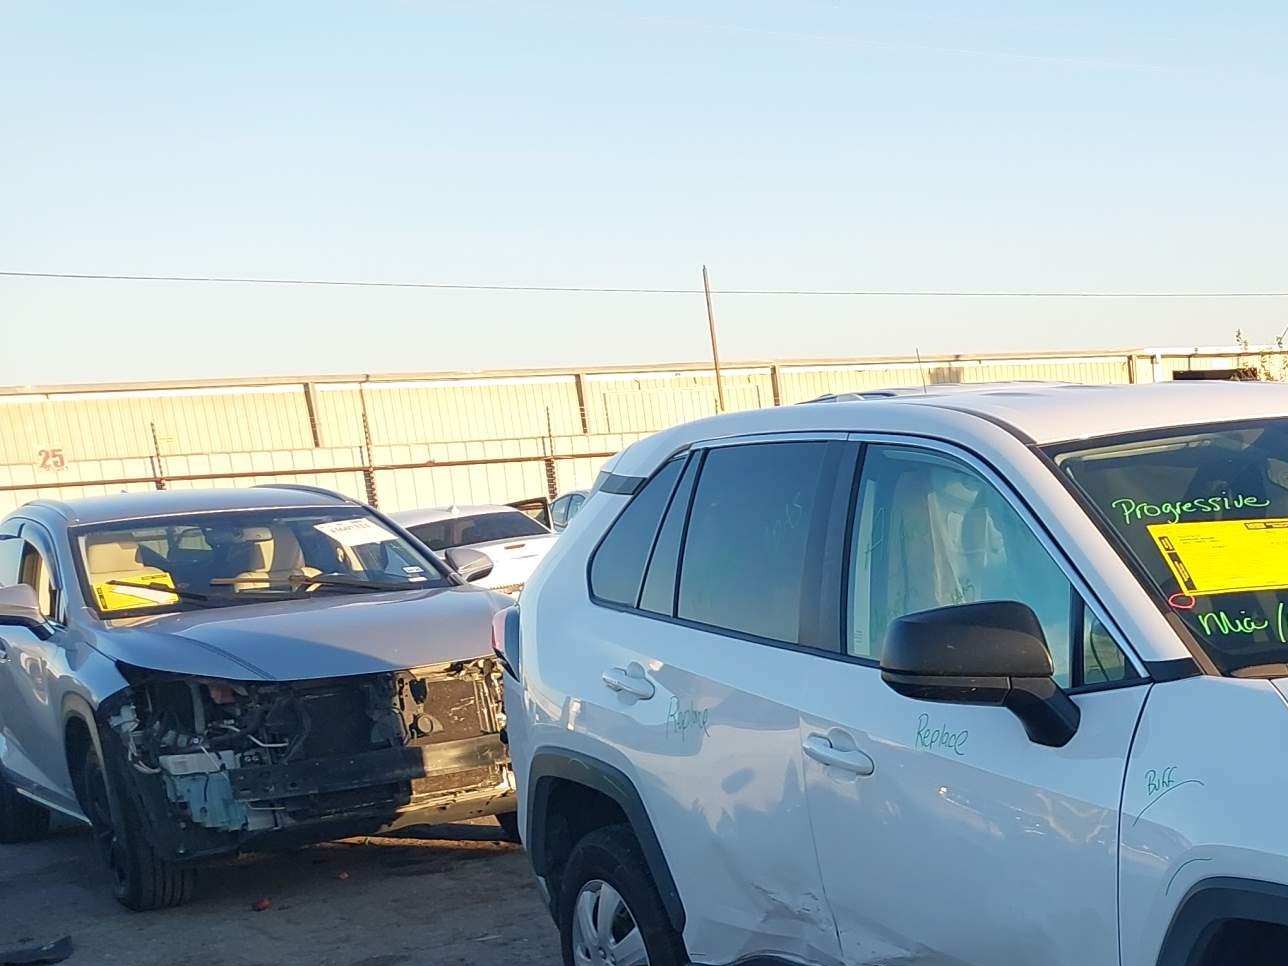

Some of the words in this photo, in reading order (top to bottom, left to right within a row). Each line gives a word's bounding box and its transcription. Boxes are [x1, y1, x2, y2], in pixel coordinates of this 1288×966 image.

[38, 448, 65, 470] 25
[1112, 491, 1270, 524] Progressive
[915, 713, 969, 756] Replace
